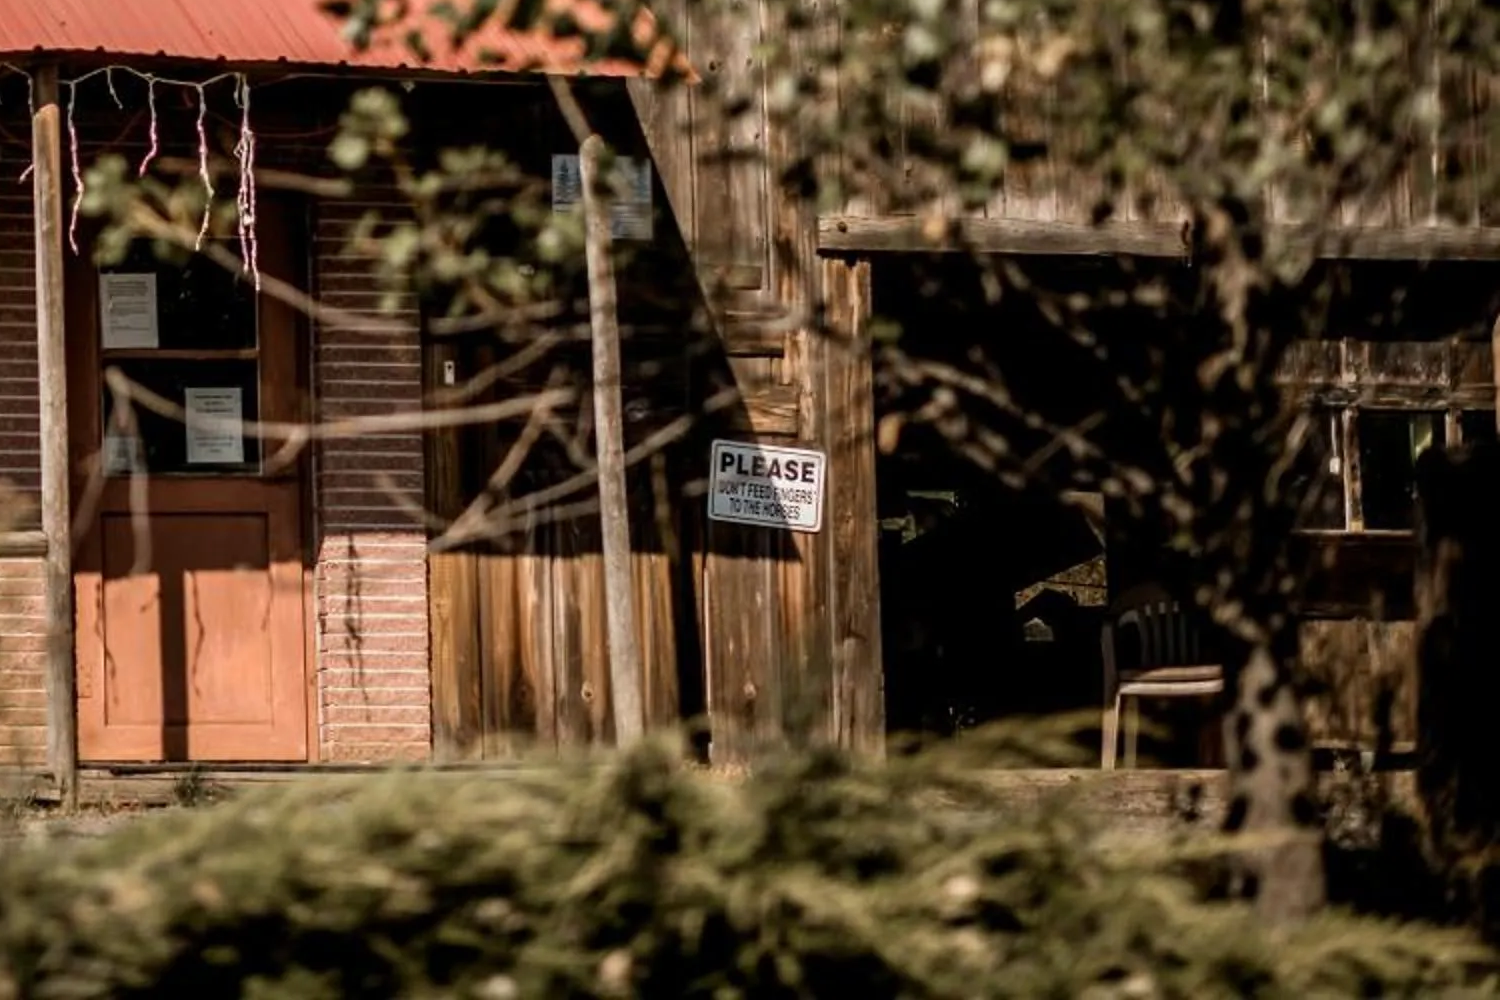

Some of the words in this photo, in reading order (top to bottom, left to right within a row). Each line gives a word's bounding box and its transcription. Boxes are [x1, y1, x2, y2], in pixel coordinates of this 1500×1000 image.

[720, 452, 815, 483] PLEASE
[747, 482, 772, 500] FEED
[729, 497, 741, 513] TO
[743, 498, 762, 516] THE
[763, 501, 802, 520] HORSES
